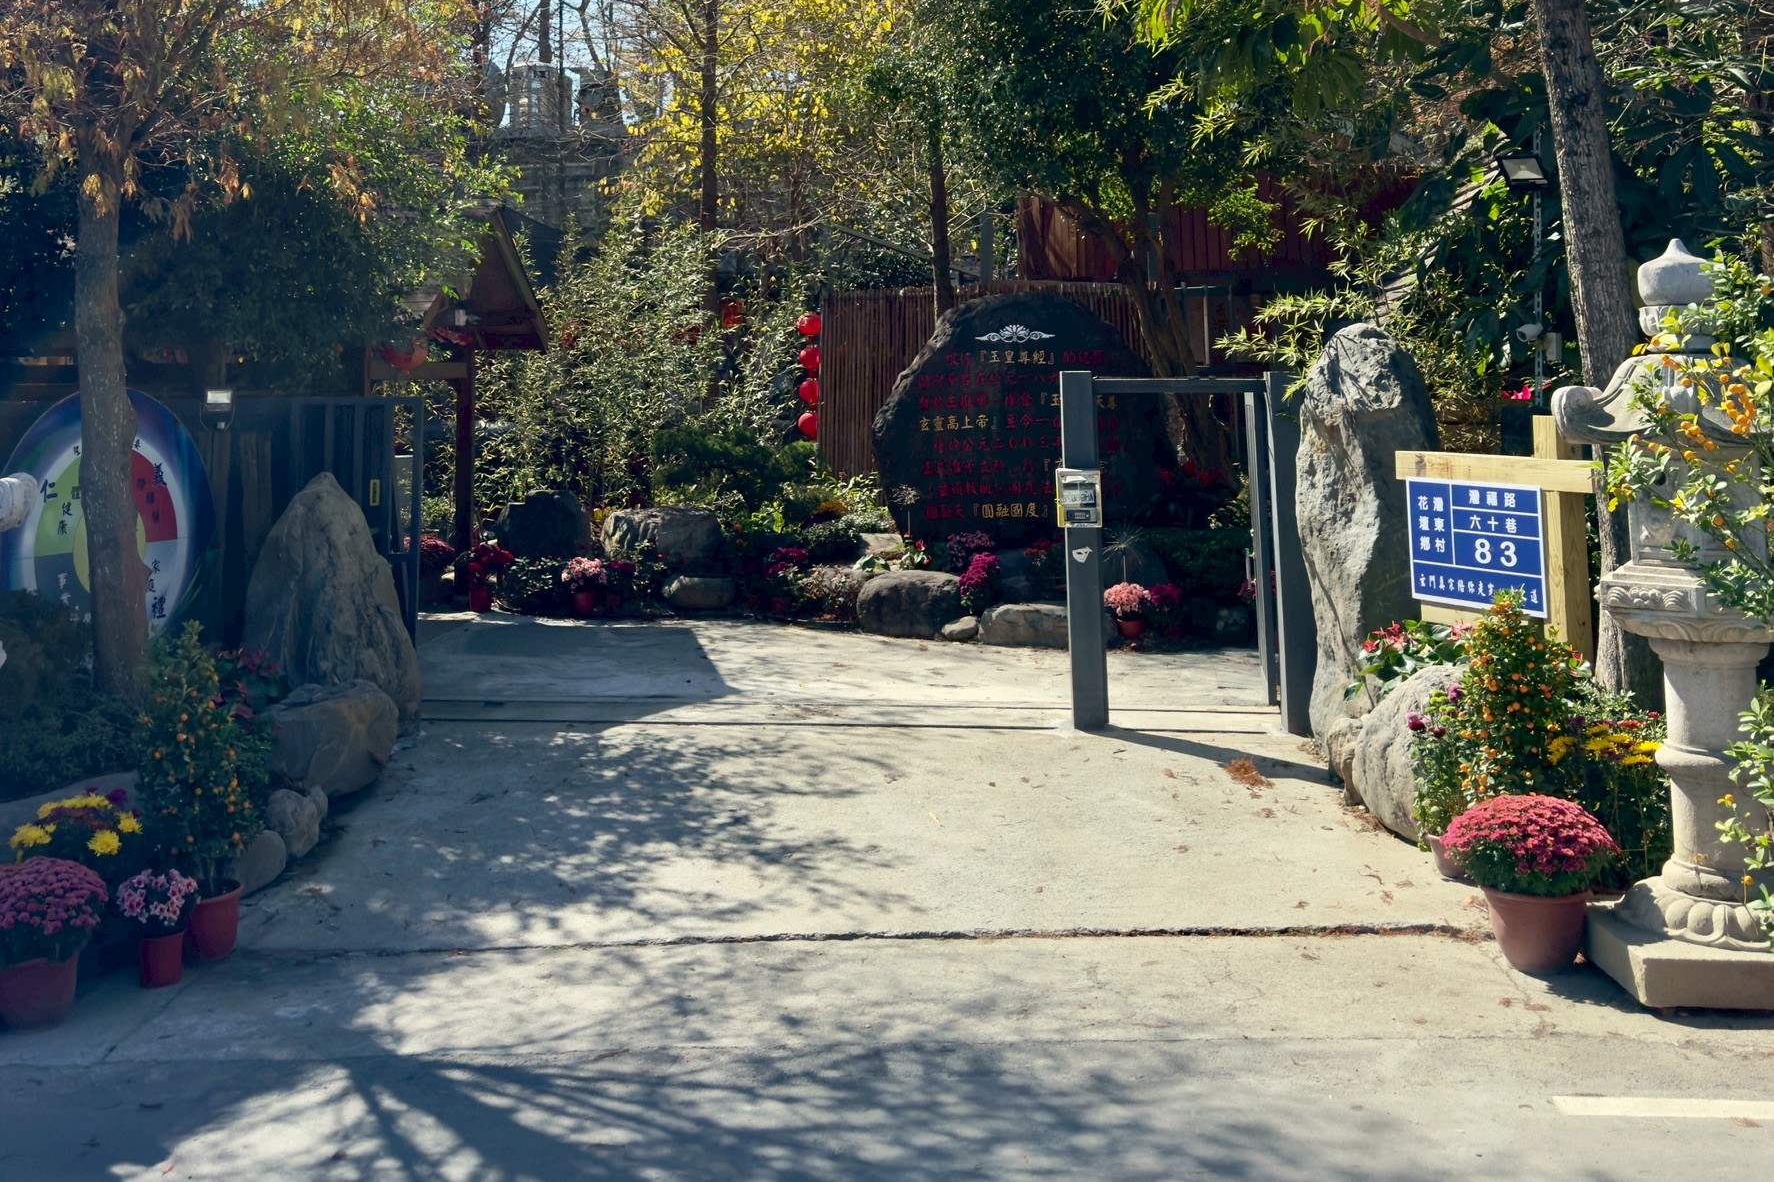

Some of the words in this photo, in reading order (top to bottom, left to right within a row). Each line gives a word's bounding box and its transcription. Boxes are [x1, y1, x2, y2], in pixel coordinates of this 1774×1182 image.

[40, 479, 58, 503] 仁
[1468, 489, 1516, 508] 灣福路
[1418, 495, 1431, 551] 花壇鄉
[1433, 496, 1446, 553] 灣東村
[1469, 514, 1517, 534] 六十巷
[1474, 538, 1518, 567] 83
